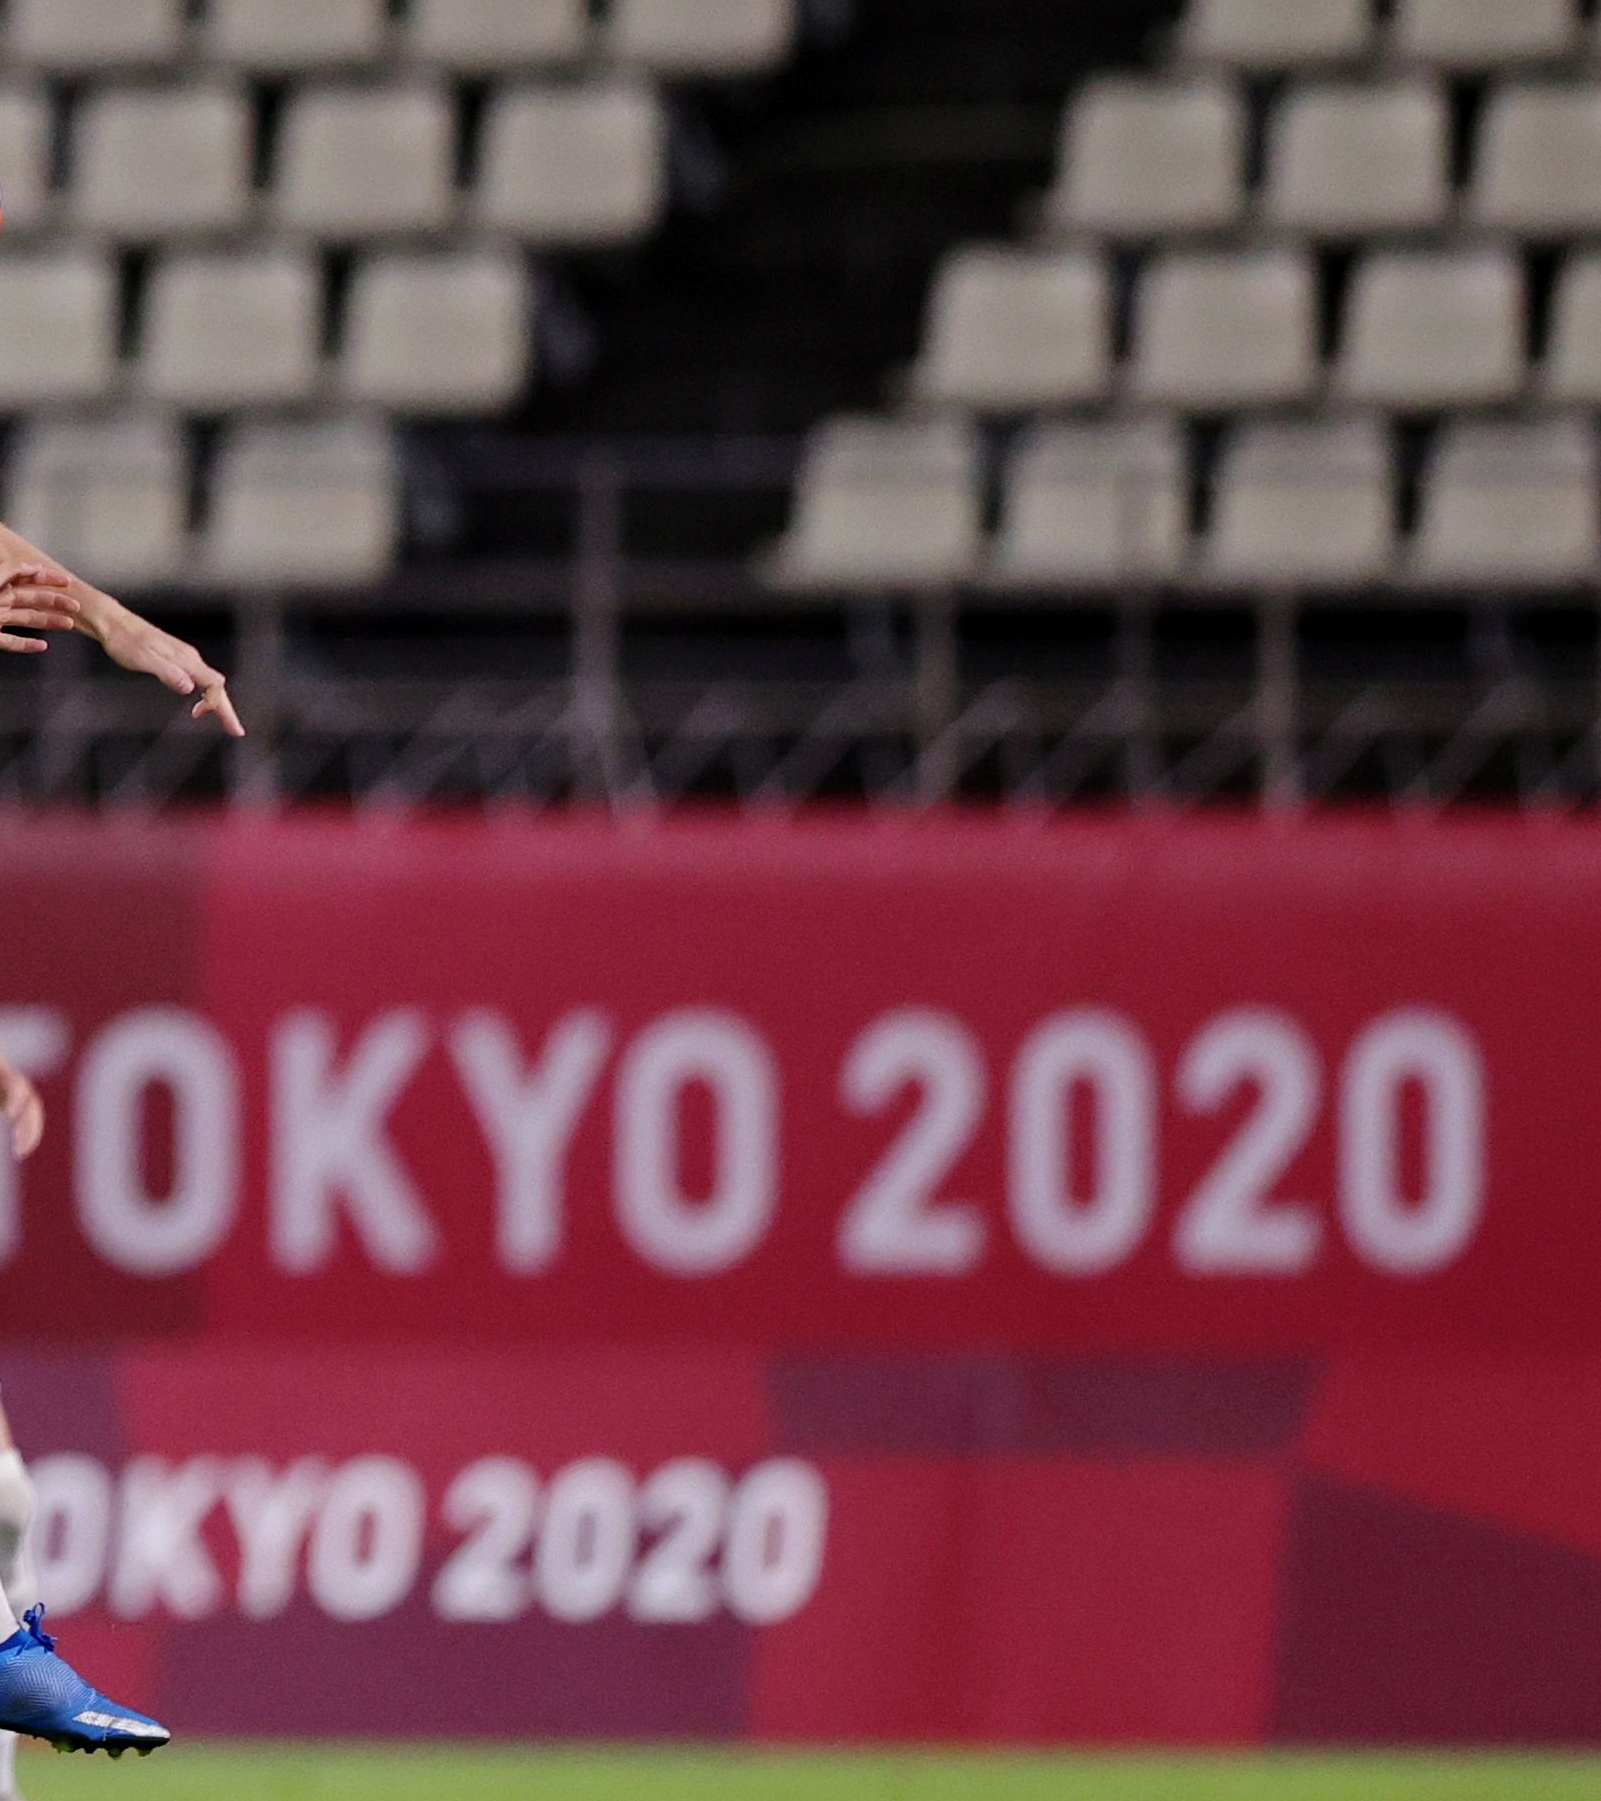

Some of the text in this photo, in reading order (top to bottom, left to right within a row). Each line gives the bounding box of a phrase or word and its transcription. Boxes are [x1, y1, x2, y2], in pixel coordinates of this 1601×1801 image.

[835, 1004, 1488, 1277] 2020
[31, 1454, 828, 1624] OKYO 2020
